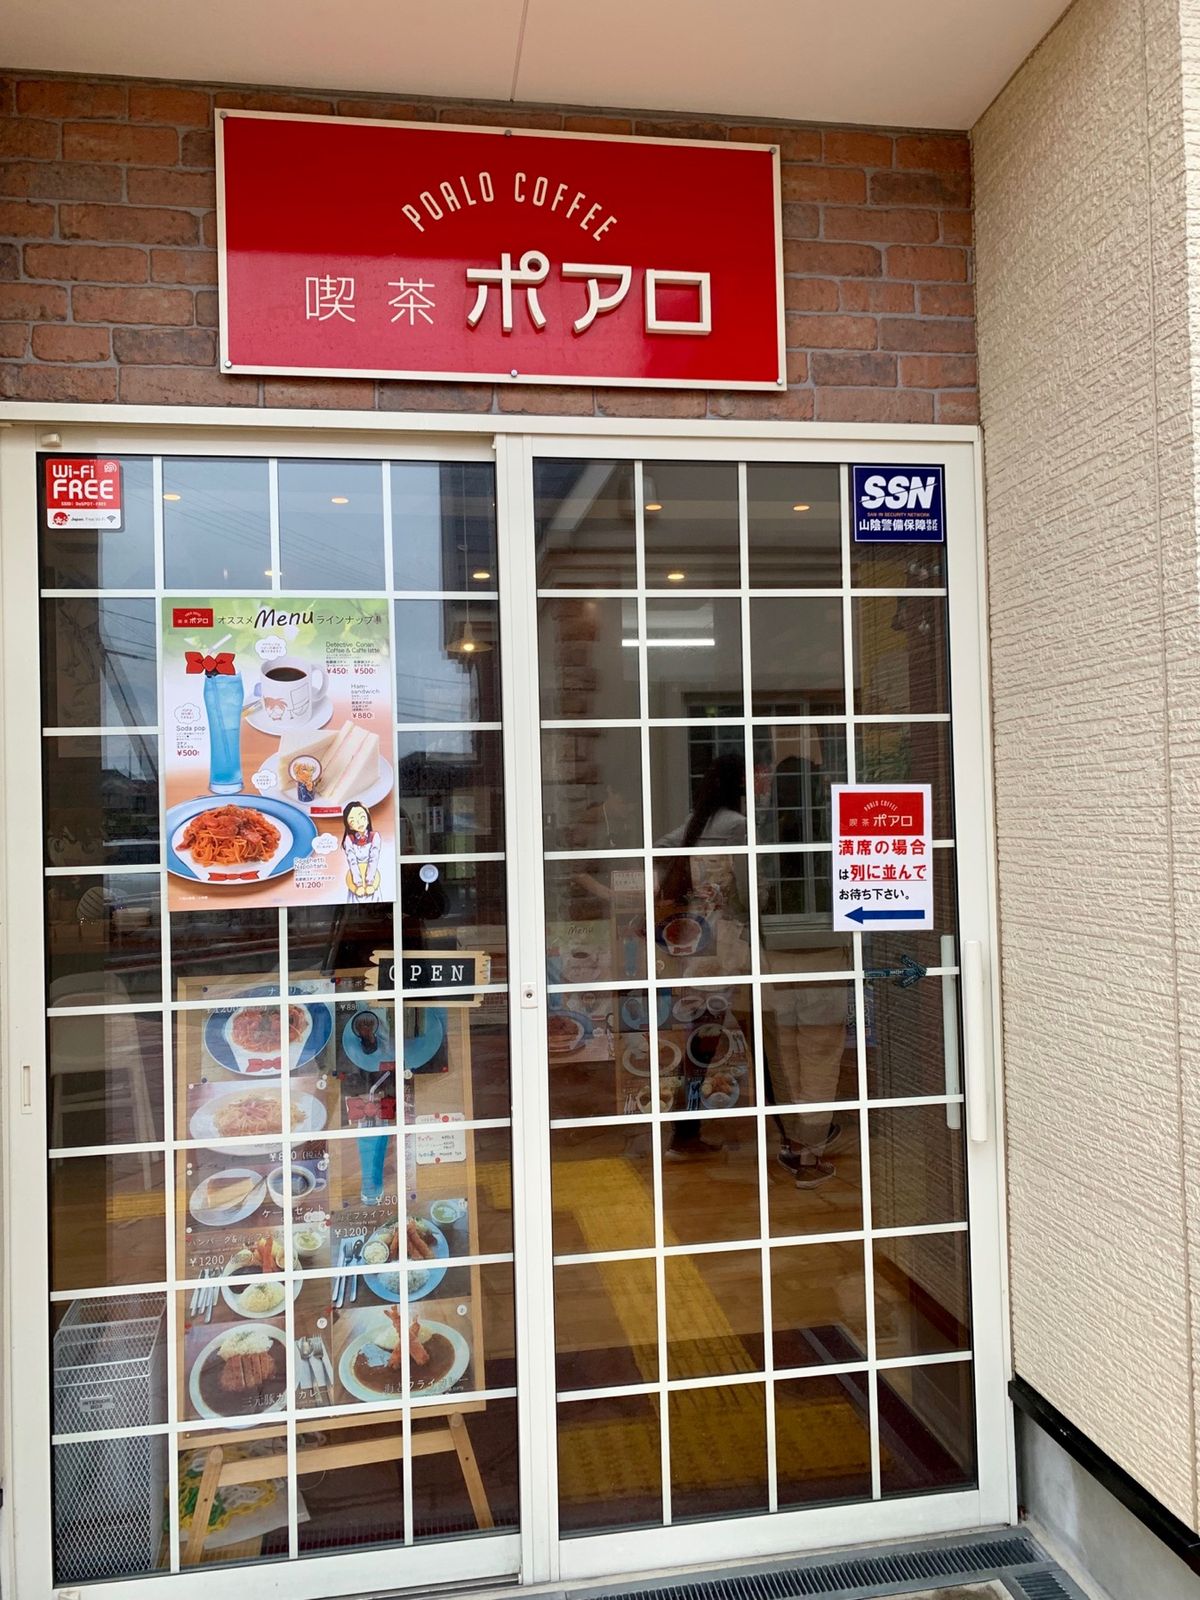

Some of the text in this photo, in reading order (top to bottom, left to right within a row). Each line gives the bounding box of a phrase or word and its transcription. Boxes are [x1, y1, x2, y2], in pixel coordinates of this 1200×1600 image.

[514, 172, 617, 242] COFFEE
[466, 250, 712, 335] ポアロ
[52, 464, 95, 479] Wi-Fi
[53, 479, 114, 500] FREE
[860, 474, 937, 510] SSN
[217, 616, 253, 625] オススメ
[253, 608, 314, 629] Menu
[176, 749, 198, 757] ¥500
[880, 799, 898, 811] COFFEE
[873, 813, 913, 827] ポアロ
[838, 838, 926, 856] 満席の場合
[838, 863, 927, 881] は列に並んで
[838, 888, 910, 901] お待ち下さい。
[269, 1151, 297, 1162] ¥80
[262, 1204, 324, 1218] ケーセット
[334, 1226, 368, 1238] ¥1200
[189, 1254, 225, 1267] ¥1200
